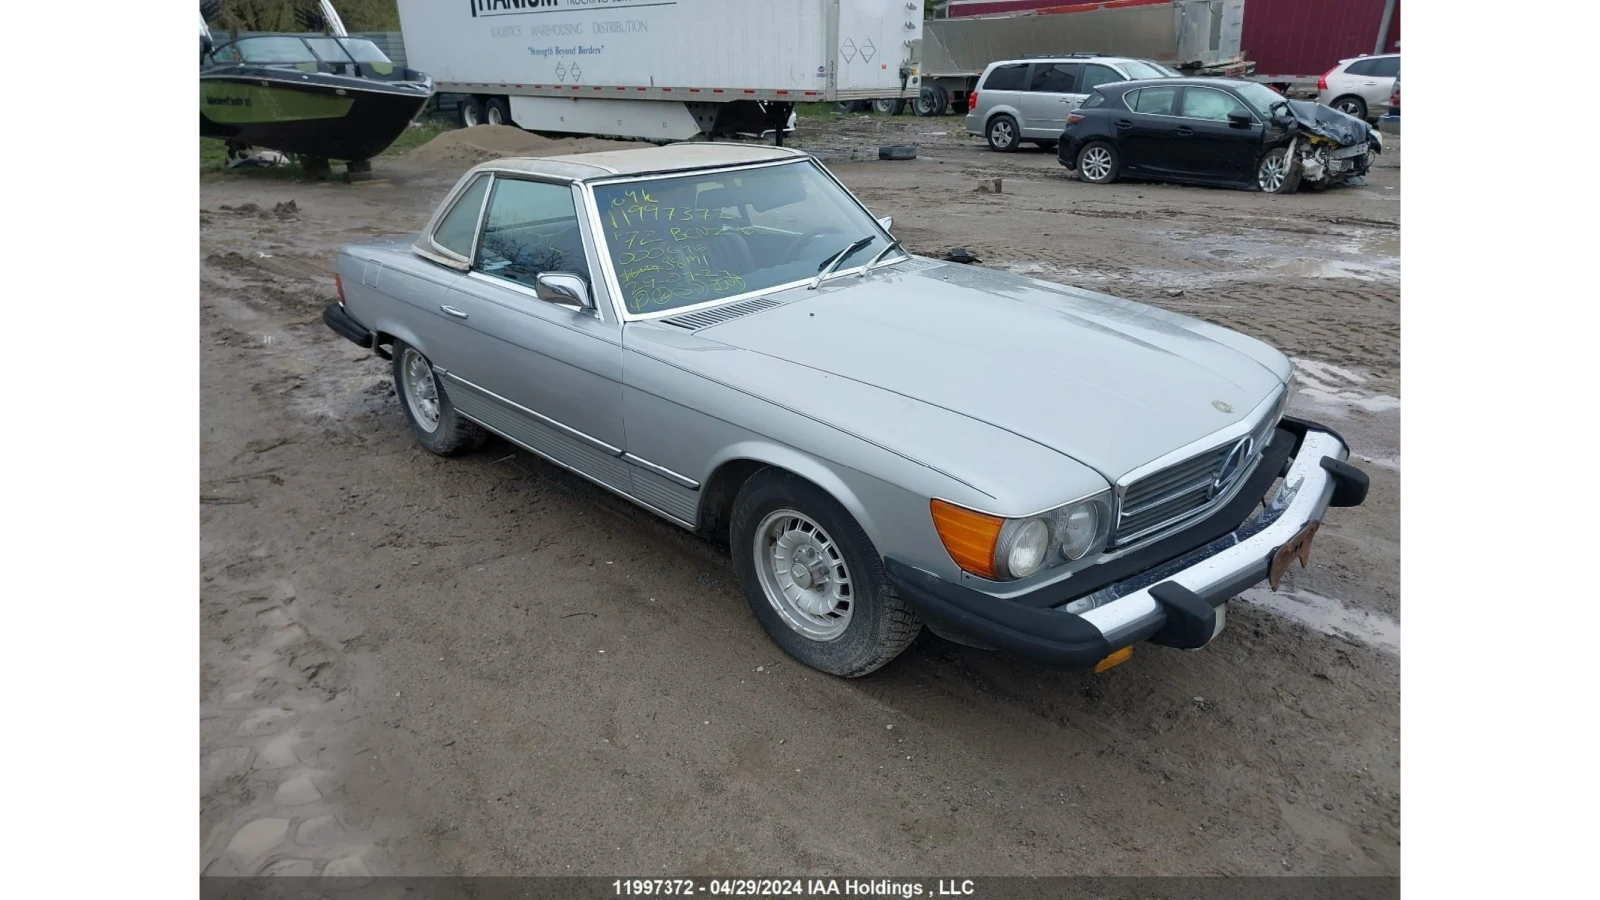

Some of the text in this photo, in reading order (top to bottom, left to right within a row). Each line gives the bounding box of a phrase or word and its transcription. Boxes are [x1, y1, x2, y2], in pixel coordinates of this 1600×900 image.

[490, 19, 649, 38] LOGISTICS WAREHOUSING DISTRIBUTION
[528, 45, 605, 58] "Strength Beyond Borders"
